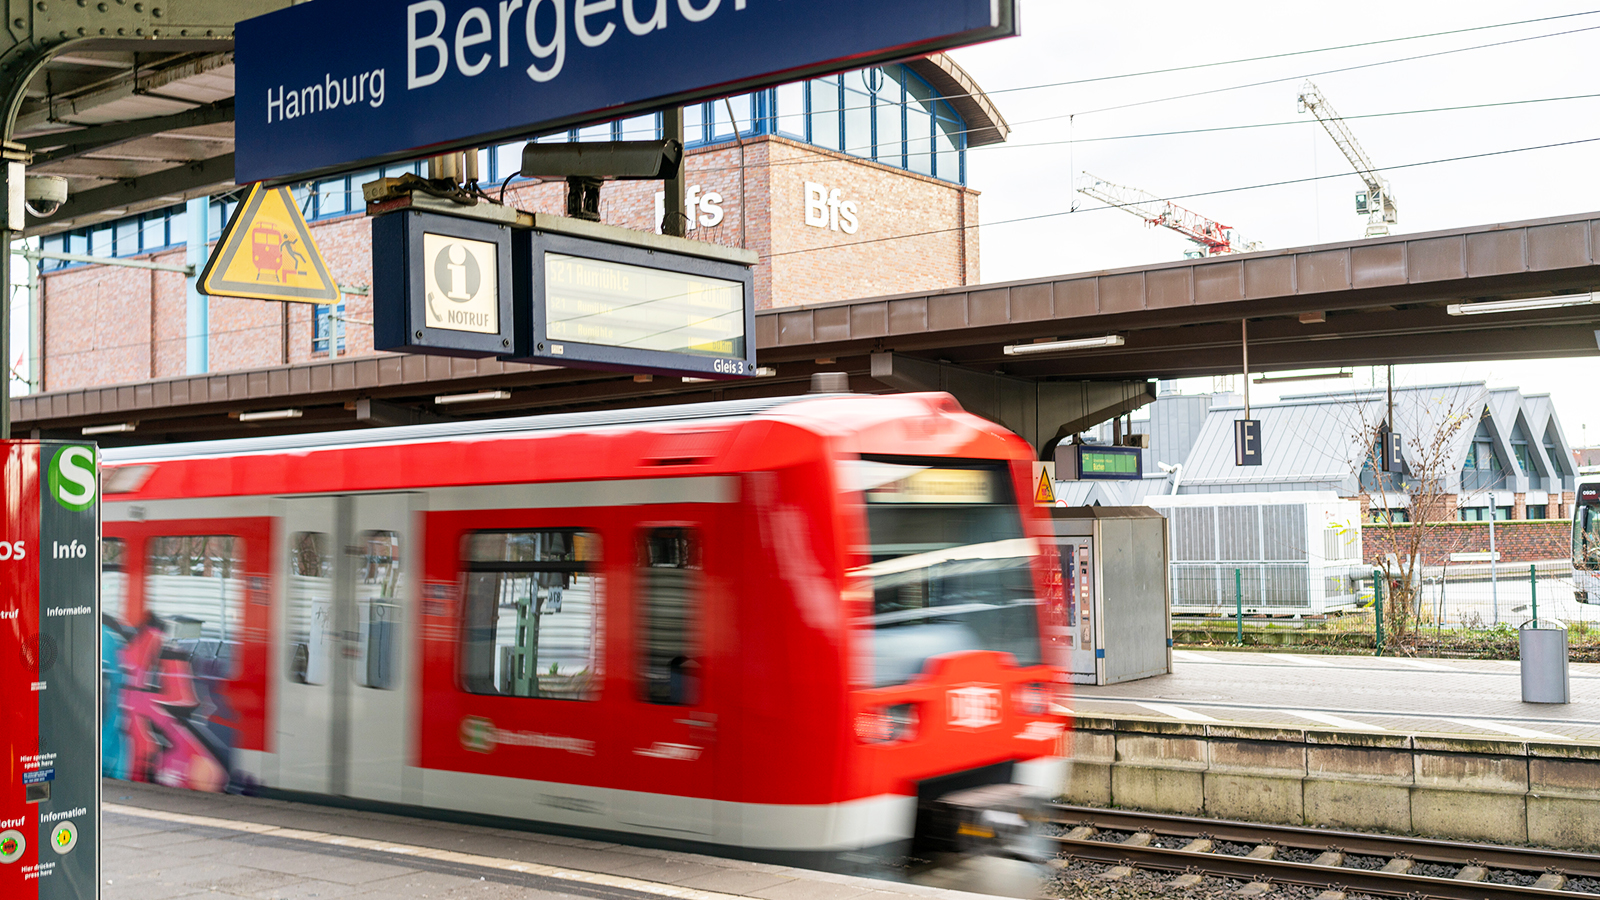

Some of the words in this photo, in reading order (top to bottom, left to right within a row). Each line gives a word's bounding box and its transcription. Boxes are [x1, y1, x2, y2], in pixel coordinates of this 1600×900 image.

[407, 0, 781, 90] Berge
[267, 68, 385, 124] Hamburg
[804, 181, 859, 235] Bfs
[550, 260, 573, 284] S21
[576, 264, 629, 292] Aumühle
[447, 309, 489, 327] NOTRUF
[713, 358, 737, 374] Gleis
[737, 361, 744, 375] 3
[1245, 421, 1255, 455] E
[1393, 434, 1401, 463] E
[59, 446, 96, 505] S
[53, 539, 87, 559] Info
[0, 608, 19, 620] truf
[46, 604, 92, 617] Information
[0, 815, 25, 829] otruf
[41, 807, 87, 824] Information
